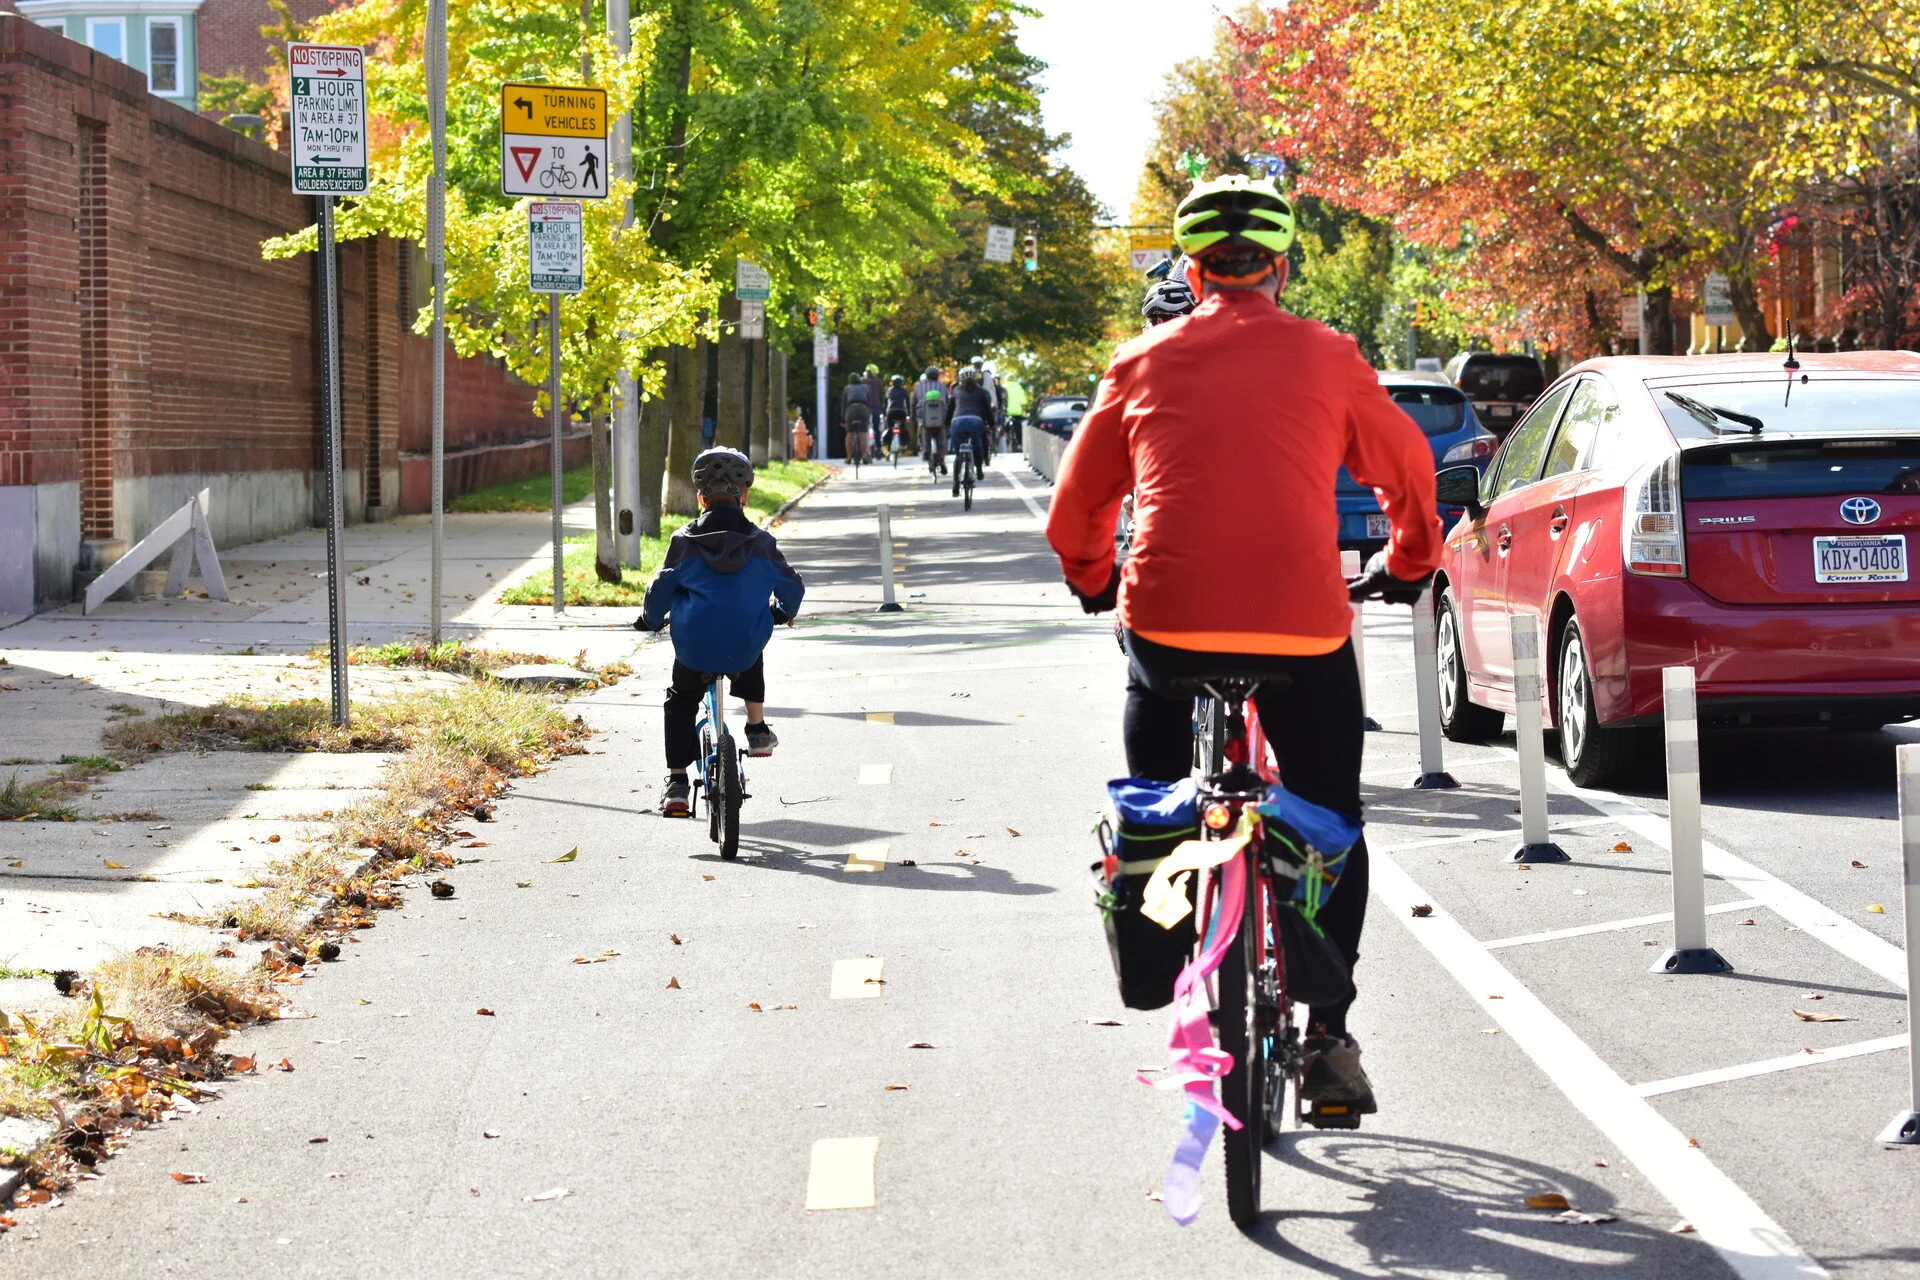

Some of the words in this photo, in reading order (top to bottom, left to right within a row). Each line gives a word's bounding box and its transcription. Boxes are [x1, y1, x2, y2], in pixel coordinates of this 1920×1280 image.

[294, 49, 308, 63] NO
[310, 51, 359, 67] STOPPING
[297, 79, 304, 94] 2
[318, 82, 354, 96] HOUR
[298, 97, 334, 111] PARKING
[338, 99, 358, 111] LIMIT
[544, 95, 595, 109] TURNING
[300, 112, 307, 123] IN
[311, 112, 334, 124] AREA
[338, 113, 343, 124] #
[348, 113, 358, 125] 37
[544, 116, 596, 130] VEHICLES
[301, 126, 358, 143] 7AM-10PM
[552, 146, 564, 159] TO
[298, 168, 317, 177] AREA
[319, 169, 324, 177] #
[327, 169, 336, 178] 37
[338, 169, 362, 178] PERMIT
[331, 180, 364, 190] EXCEPTED
[532, 205, 542, 214] NO
[544, 206, 579, 214] STOPPING
[534, 223, 540, 232] 2
[547, 224, 570, 233] HOUR
[535, 233, 560, 241] PARKING
[536, 251, 577, 261] 7AM-10PM
[1699, 516, 1756, 525] PRIUS
